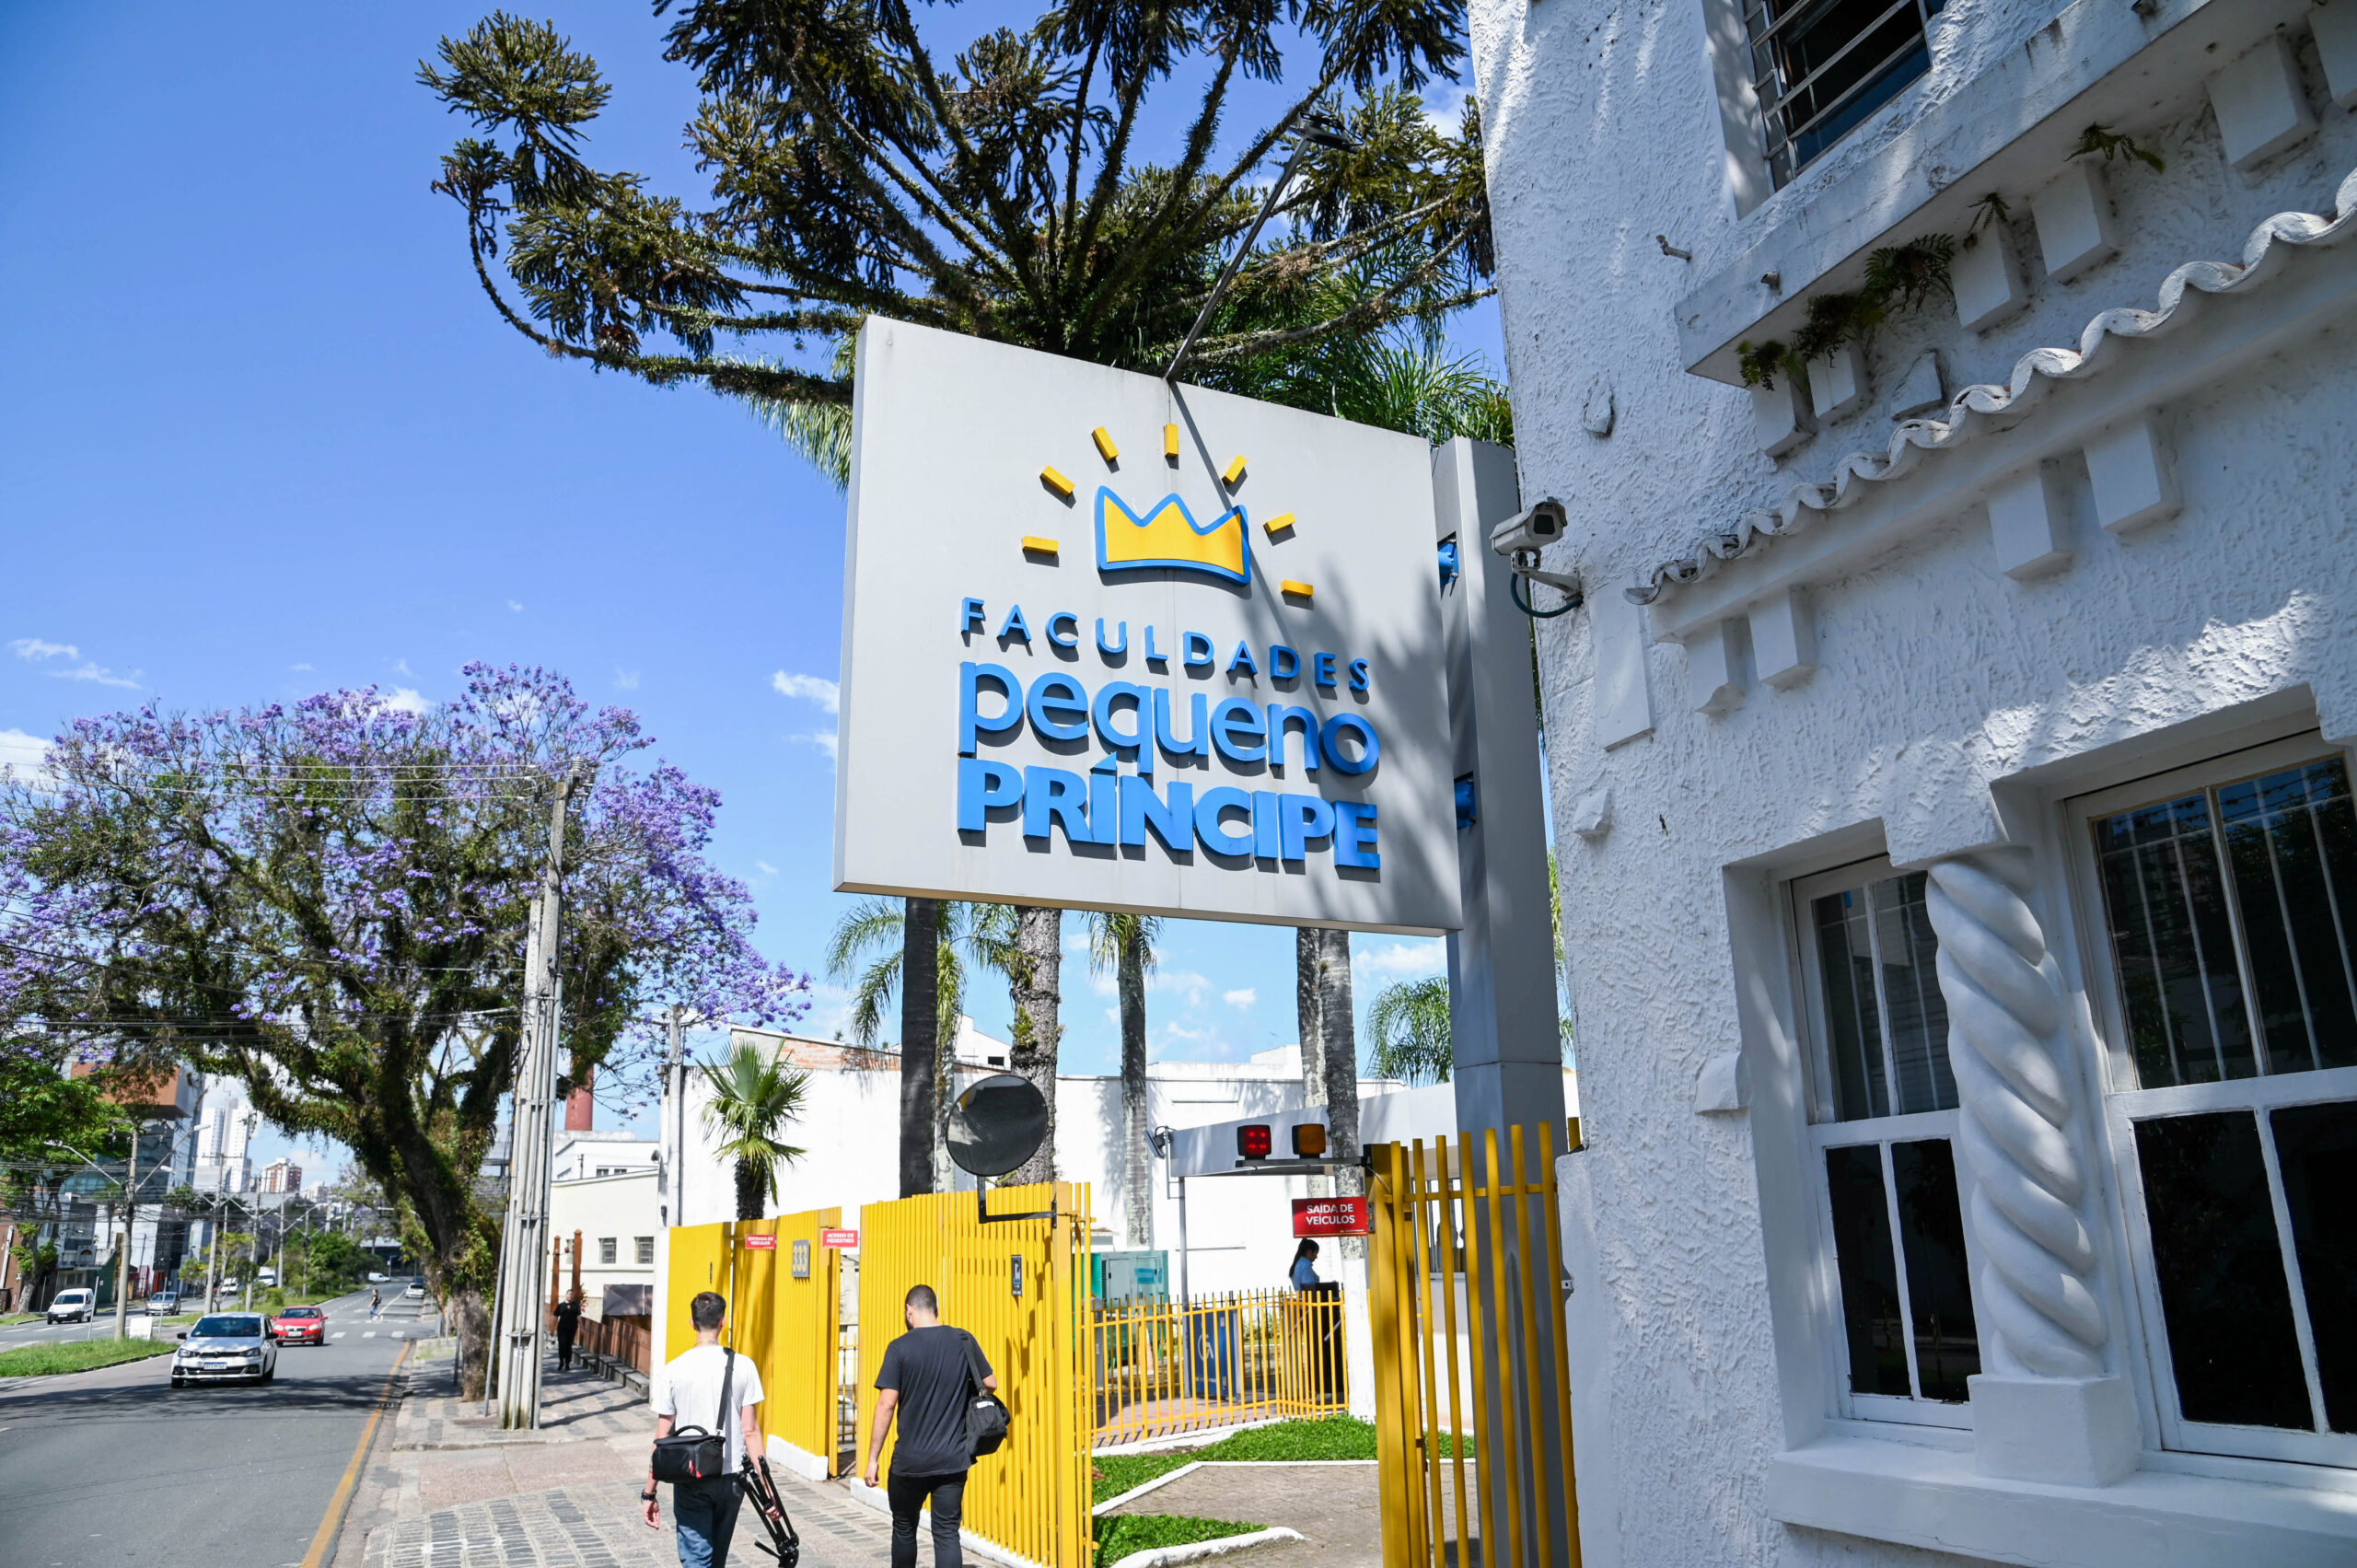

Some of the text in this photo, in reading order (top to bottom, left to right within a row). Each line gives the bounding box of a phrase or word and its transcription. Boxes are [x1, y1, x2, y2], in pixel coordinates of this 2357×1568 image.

[961, 597, 1370, 691] FACULDADES
[958, 661, 1380, 774] pequeno
[958, 751, 1380, 868] PRÍNCIPE
[1306, 1202, 1353, 1214] SAÍDA DE
[1306, 1214, 1355, 1225] VEÍCULOS
[793, 1245, 807, 1272] 333
